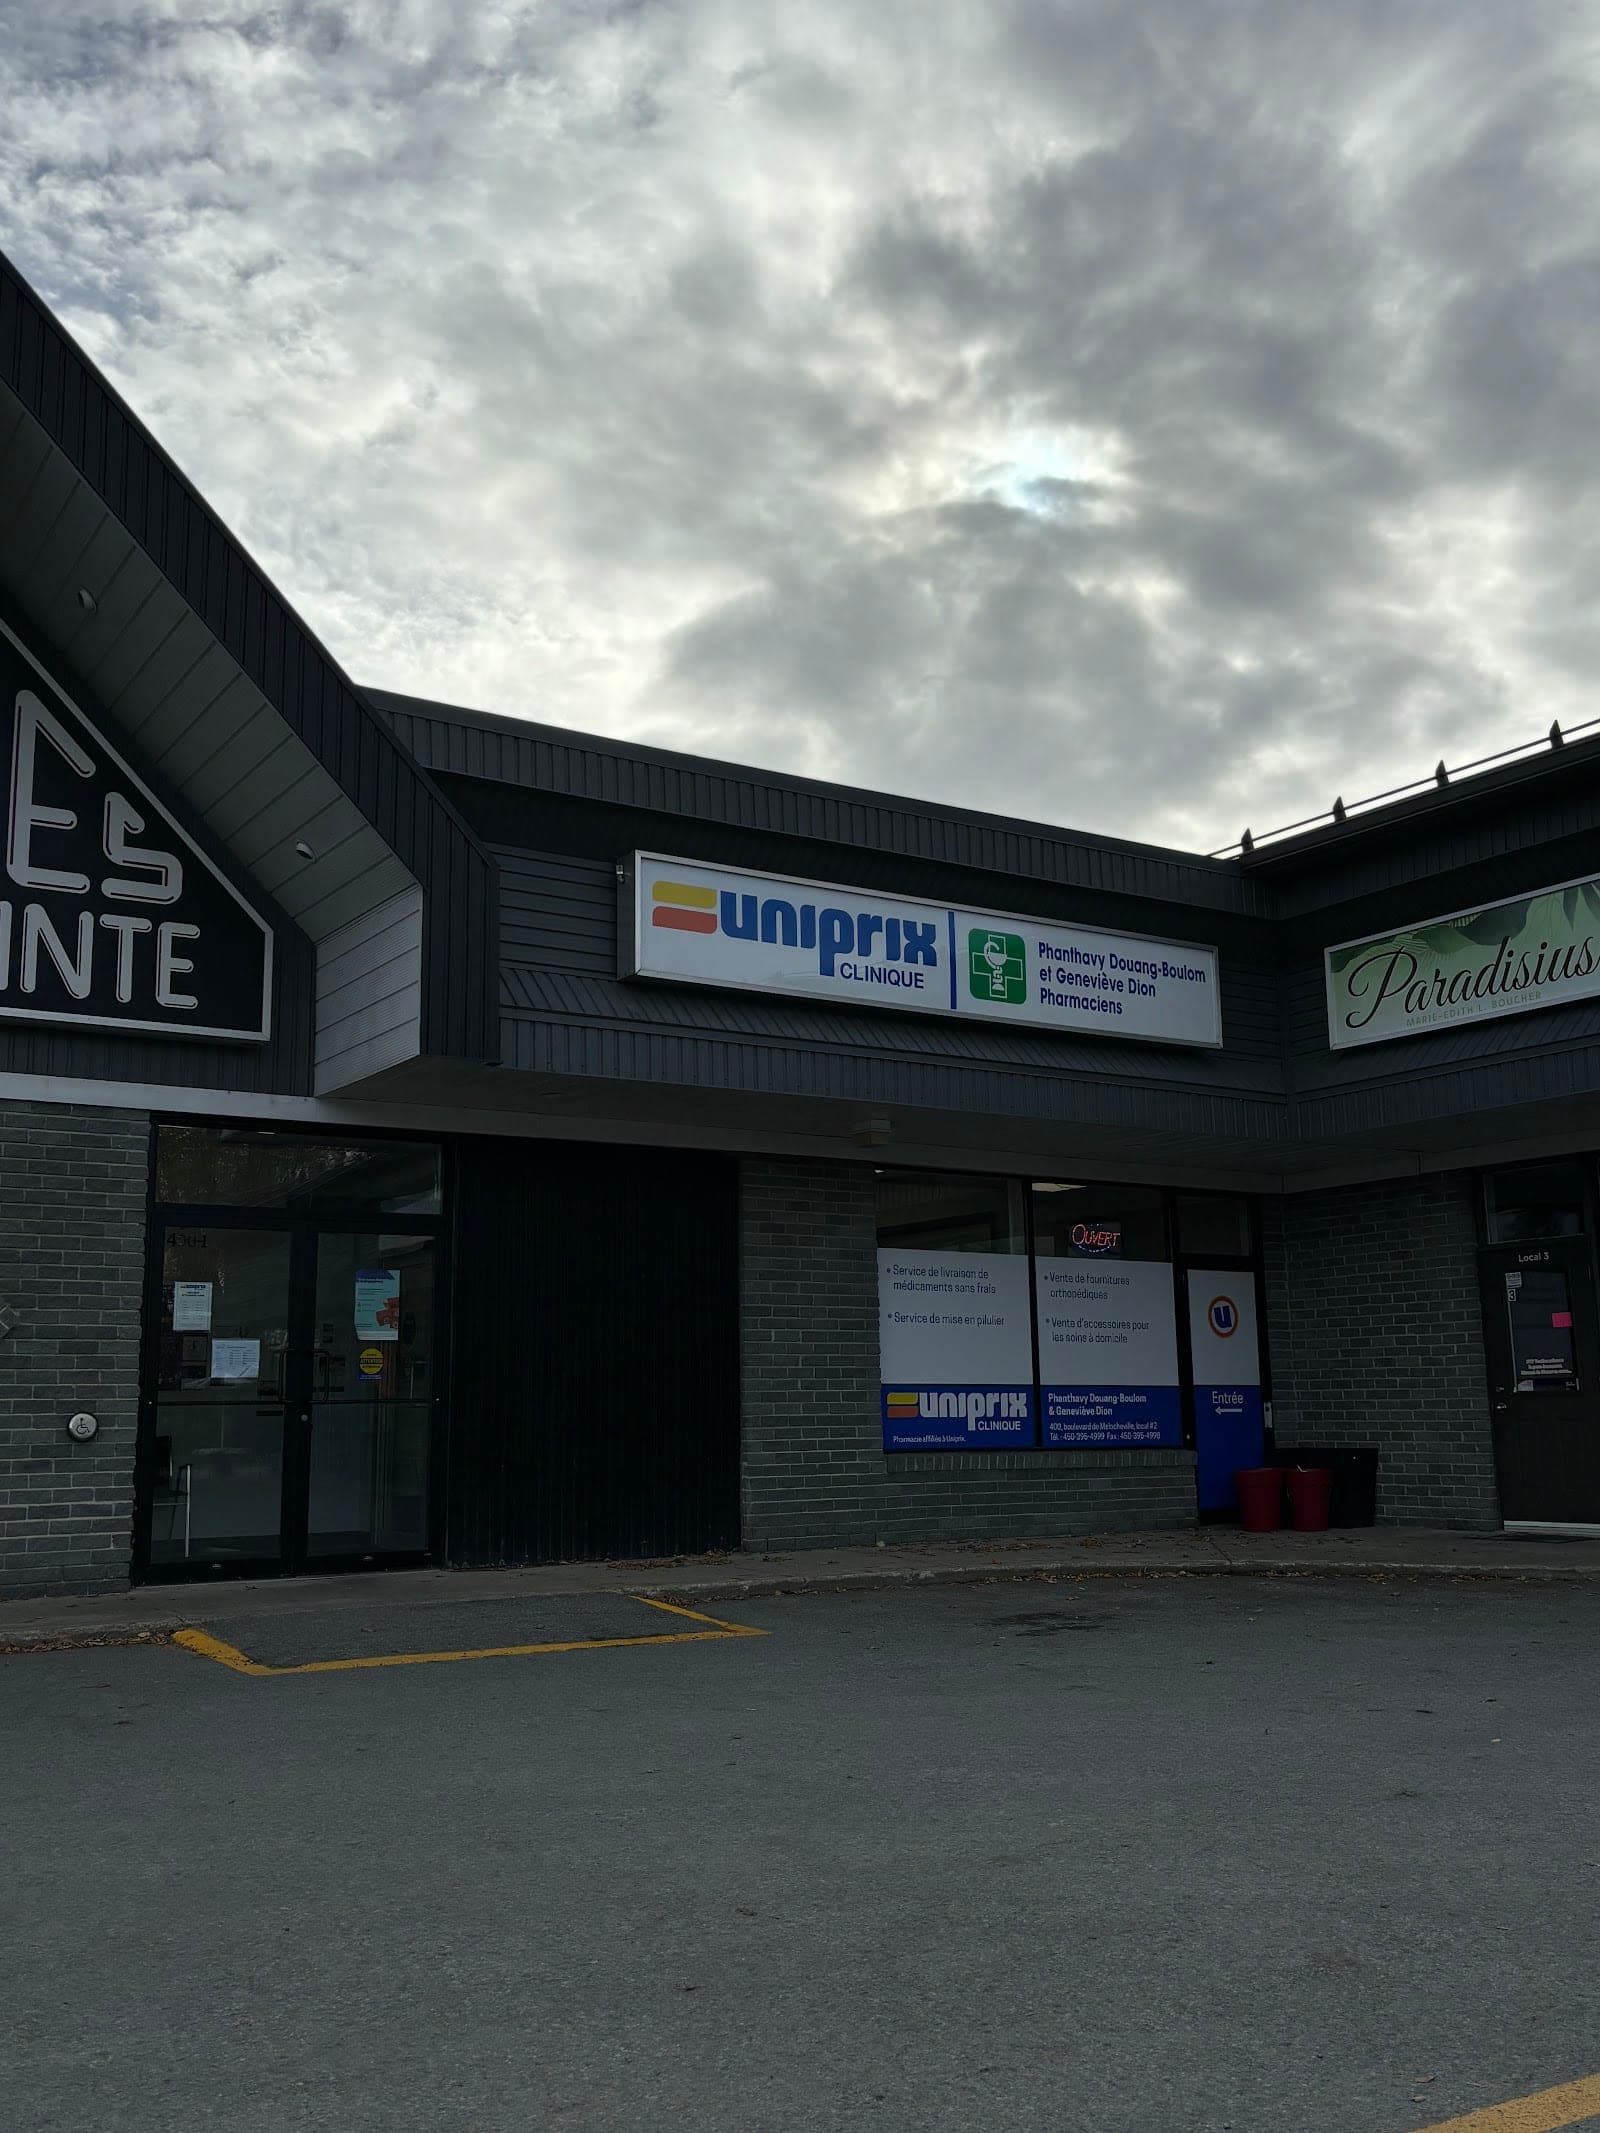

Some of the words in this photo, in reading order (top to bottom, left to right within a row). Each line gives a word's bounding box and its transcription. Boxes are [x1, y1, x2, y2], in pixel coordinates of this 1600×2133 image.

[720, 890, 938, 977] uniprix
[1038, 941, 1106, 970] Phanthavy
[1109, 953, 1207, 983] Douang-Boulom
[840, 962, 925, 989] CLINIQUE
[1039, 966, 1052, 982] et
[1056, 967, 1124, 993] Geneviève
[1128, 978, 1156, 997] Dion
[1345, 935, 1600, 1028] Paradisius
[1040, 987, 1123, 1015] Pharmaciens
[1491, 991, 1542, 1009] BOUCHER
[1518, 1251, 1542, 1263] Local
[1543, 1251, 1550, 1260] 3
[892, 1264, 927, 1277] Service
[928, 1265, 939, 1277] de
[940, 1266, 976, 1279] livraison
[978, 1268, 989, 1280] de
[1049, 1271, 1074, 1283] Vente
[1075, 1272, 1085, 1283] de
[1086, 1273, 1131, 1286] fournitures
[893, 1280, 953, 1293] médicaments
[954, 1283, 975, 1294] sans
[977, 1282, 997, 1295] frais
[1050, 1288, 1109, 1301] orthopédiques
[1509, 1290, 1515, 1300] 3
[894, 1311, 928, 1323] Service
[929, 1313, 940, 1324] de
[942, 1314, 963, 1325] mise
[964, 1316, 975, 1326] en
[977, 1314, 1006, 1328] pilulier
[1051, 1317, 1076, 1328] Vente
[1077, 1317, 1131, 1330] d'accessoires
[1132, 1320, 1150, 1333] pour
[1052, 1331, 1064, 1342] les
[1065, 1333, 1087, 1343] soins
[1088, 1332, 1094, 1343] à
[1095, 1332, 1129, 1344] domicile
[1047, 1392, 1089, 1405] Phanthavy
[1089, 1392, 1147, 1404] Douang-Boulom
[1211, 1390, 1245, 1405] Entrée
[919, 1391, 1028, 1432] uniprix
[1048, 1406, 1055, 1416] &
[1056, 1405, 1095, 1416] Geneviève
[1095, 1406, 1113, 1416] Dion
[977, 1420, 1022, 1431] CLINIQUE
[1063, 1421, 1092, 1431] boulevard
